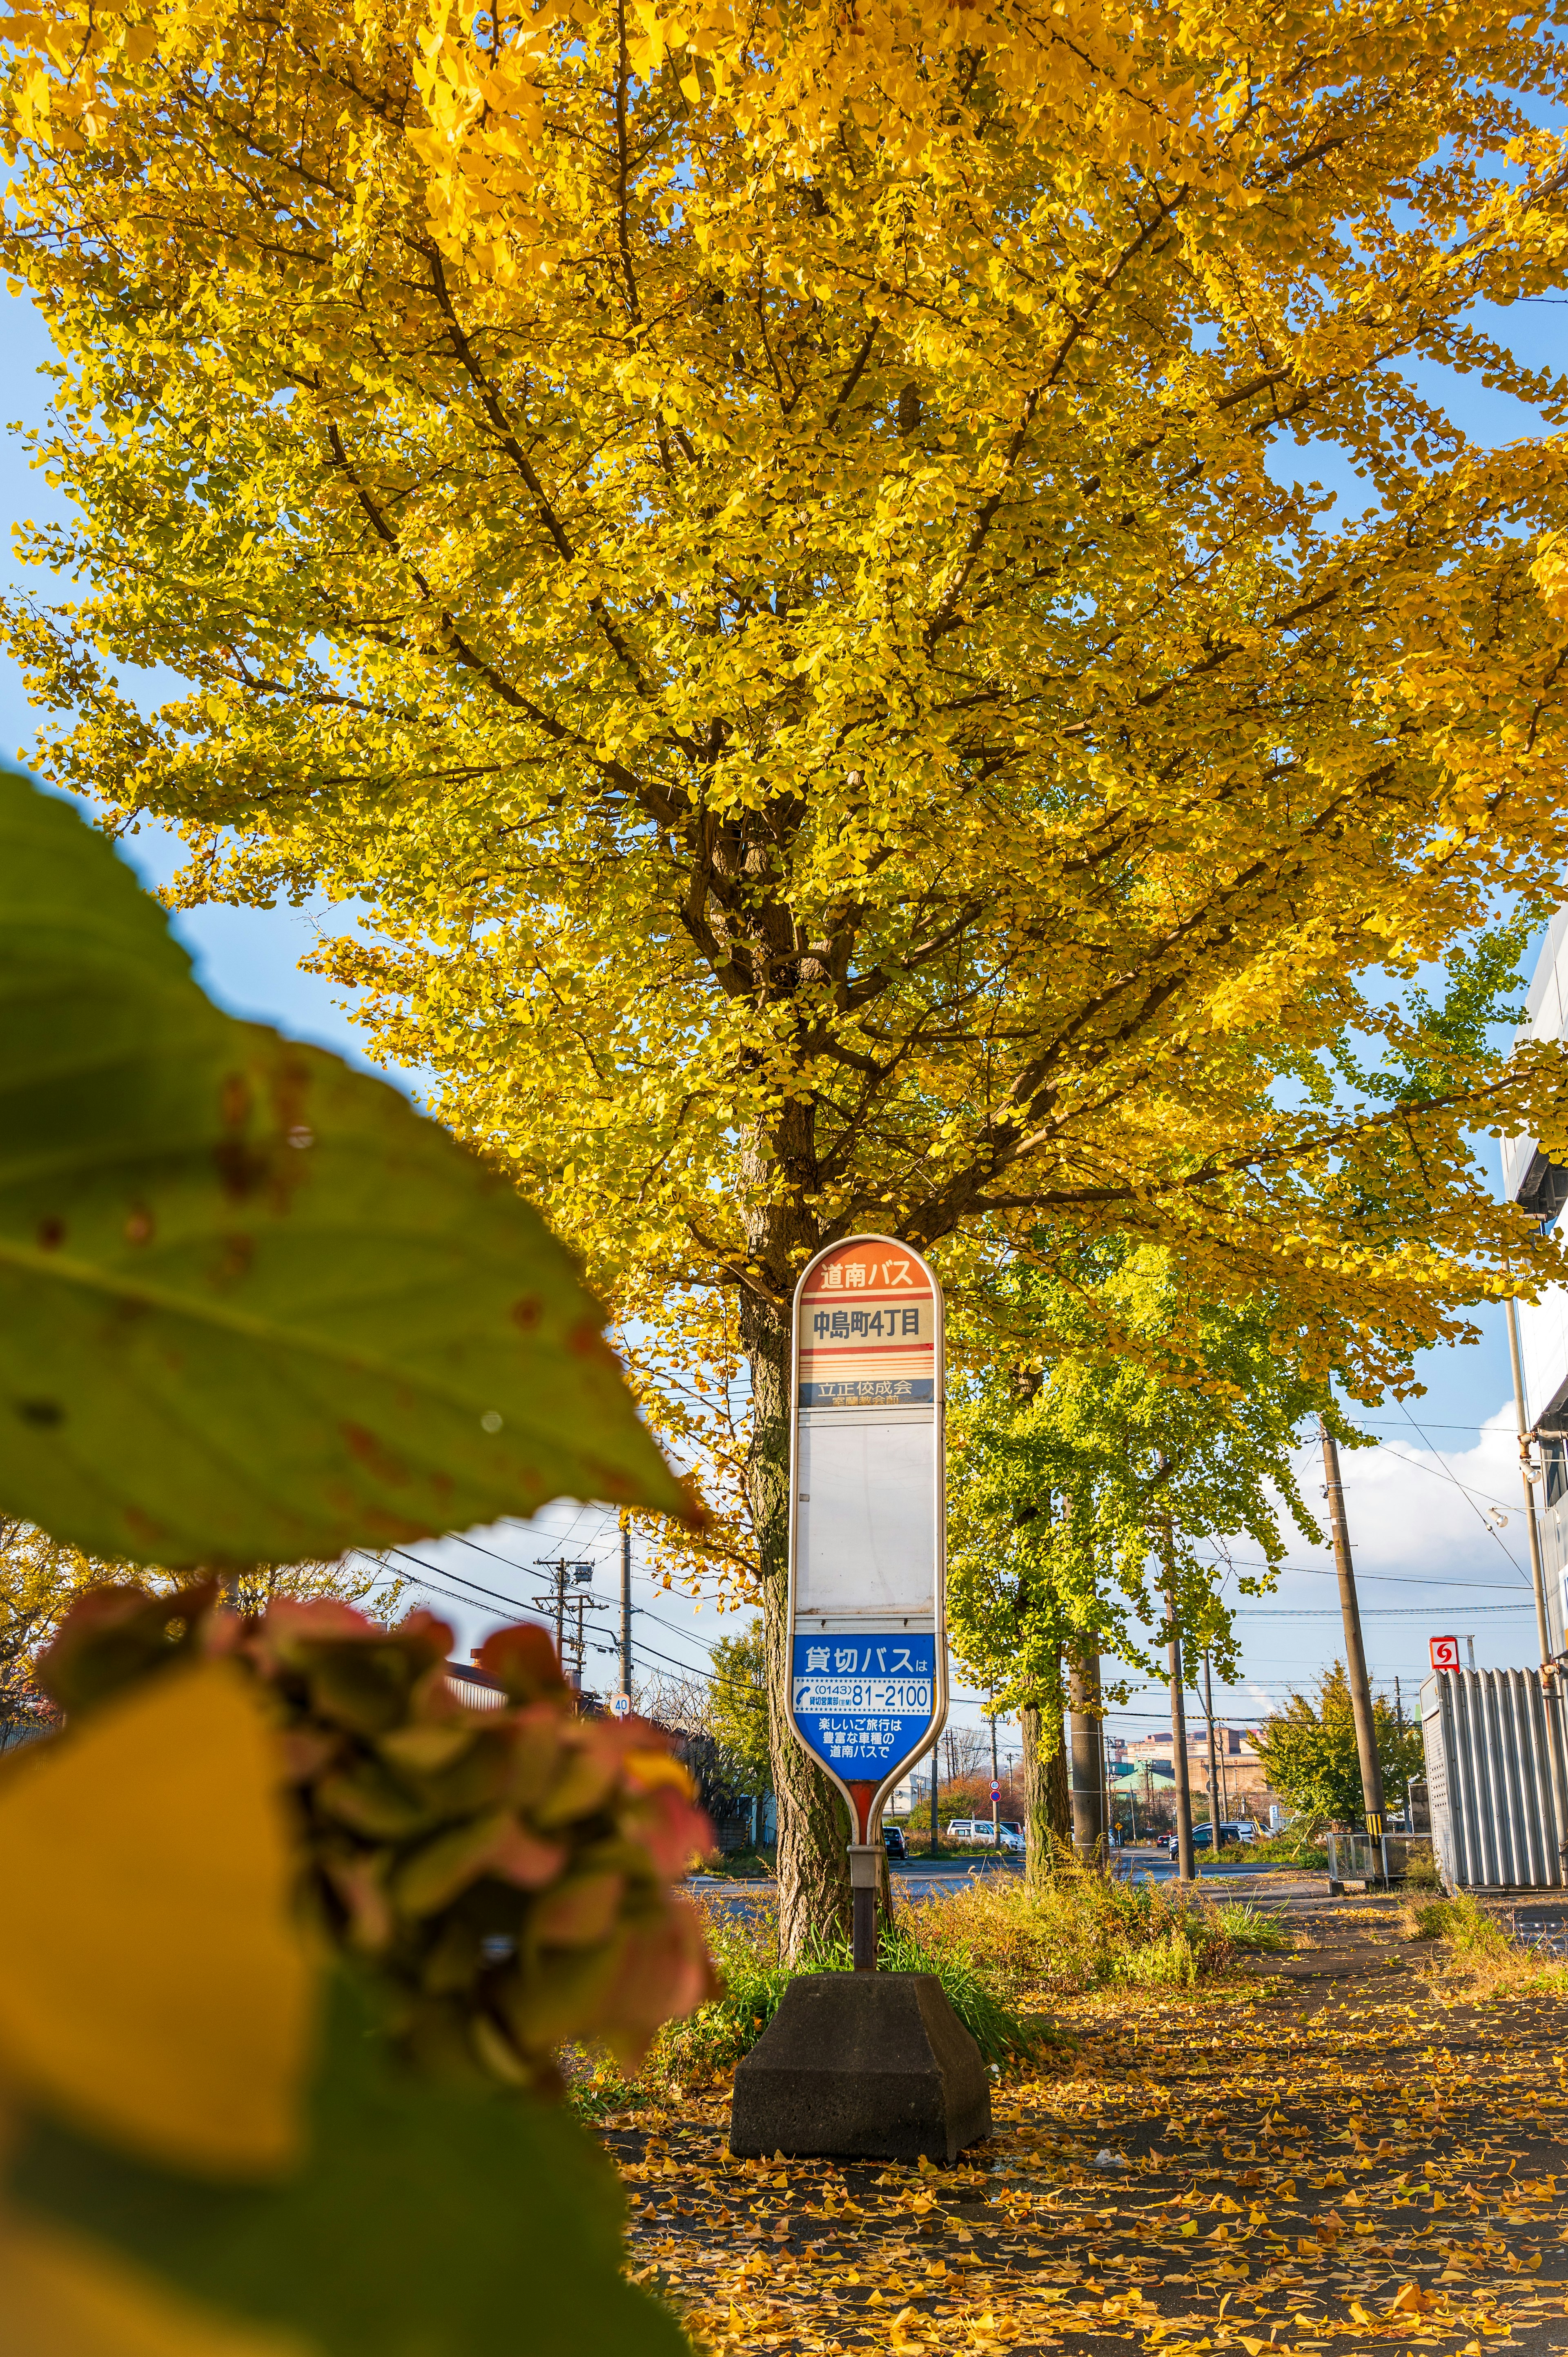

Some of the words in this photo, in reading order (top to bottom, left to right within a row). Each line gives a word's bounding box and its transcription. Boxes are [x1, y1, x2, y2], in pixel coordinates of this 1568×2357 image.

[821, 1259, 913, 1289] 道南バス
[813, 1308, 919, 1339] 中島町4丁目
[818, 1380, 912, 1397] 立正佼成会
[832, 1395, 899, 1407] 室蘭教会前
[805, 1646, 928, 1673] 貸切バスは
[615, 1699, 627, 1710] 40
[819, 1718, 902, 1731] 楽しいご旅行は
[823, 1732, 895, 1745] 豊富な車種の
[830, 1745, 890, 1759] 道南バスで
